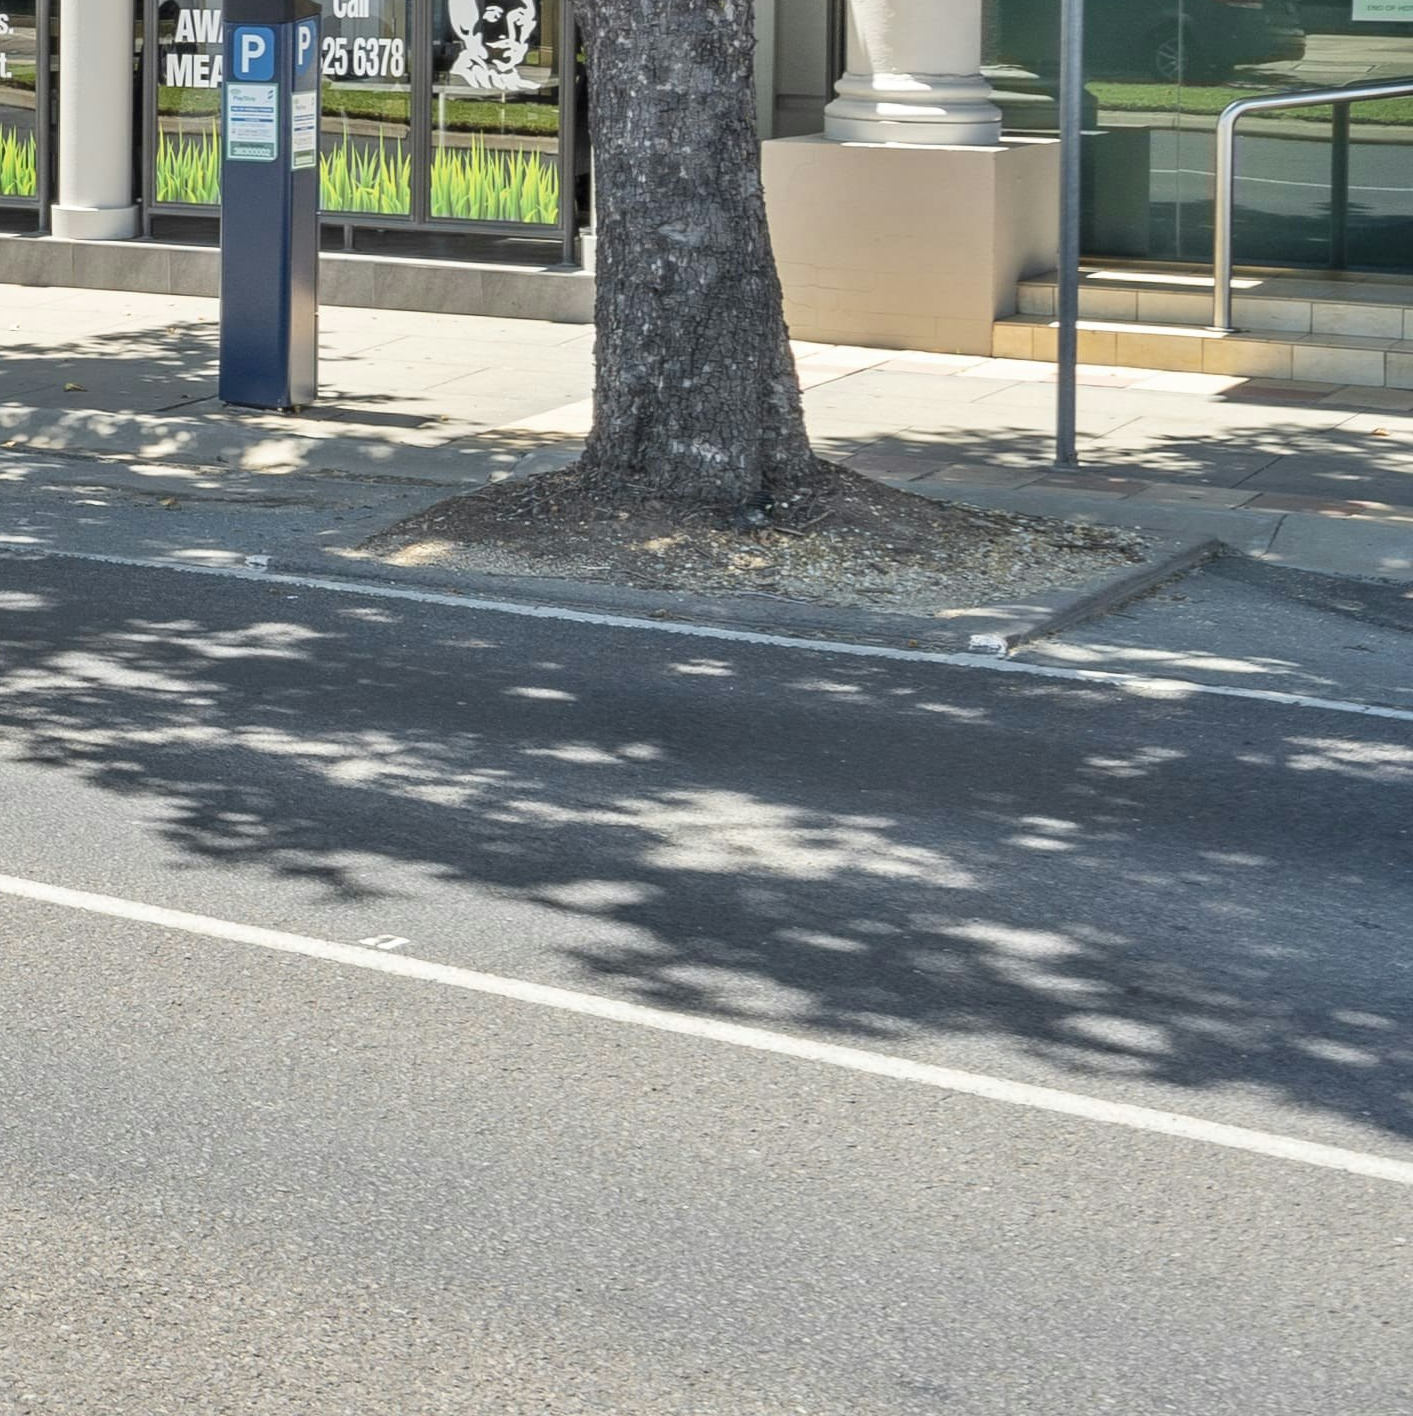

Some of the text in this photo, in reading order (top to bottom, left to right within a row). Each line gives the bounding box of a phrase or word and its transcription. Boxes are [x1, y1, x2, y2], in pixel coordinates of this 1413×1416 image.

[241, 34, 266, 73] P
[298, 25, 311, 66] P
[322, 36, 405, 78] 25 6378
[166, 53, 223, 88] MEA
